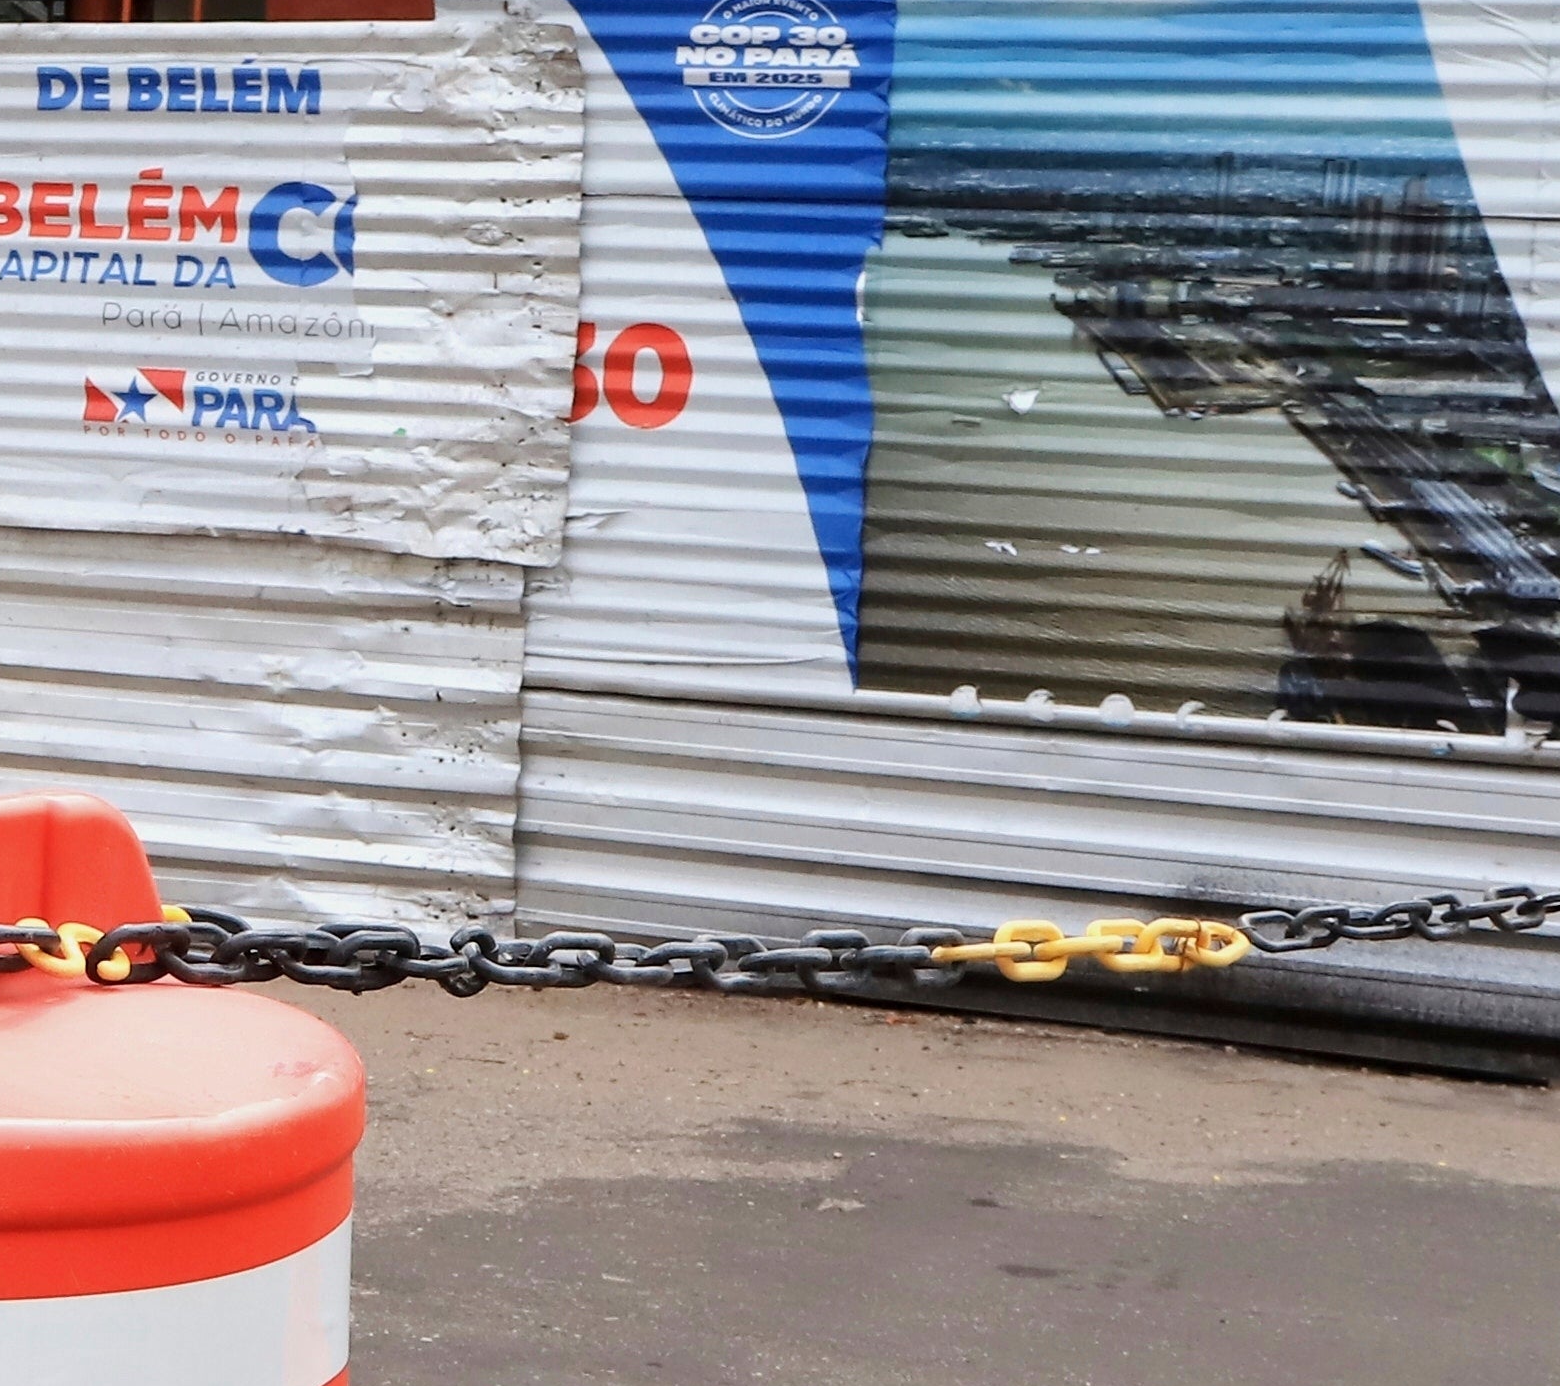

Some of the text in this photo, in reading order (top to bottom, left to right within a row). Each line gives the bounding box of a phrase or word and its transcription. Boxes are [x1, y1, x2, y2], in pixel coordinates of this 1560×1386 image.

[723, 10, 732, 20] O
[690, 24, 848, 46] COP 30
[675, 43, 860, 67] NO PARÁ
[37, 59, 321, 114] DE BELÉM
[709, 72, 823, 84] EM 2025
[765, 118, 783, 127] DO
[786, 94, 823, 123] MUNDO
[173, 254, 236, 288] DA
[102, 302, 181, 330] Pará
[195, 371, 280, 386] GOVERNO
[83, 425, 125, 437] POR
[145, 428, 206, 442] TODO
[225, 433, 236, 444] O
